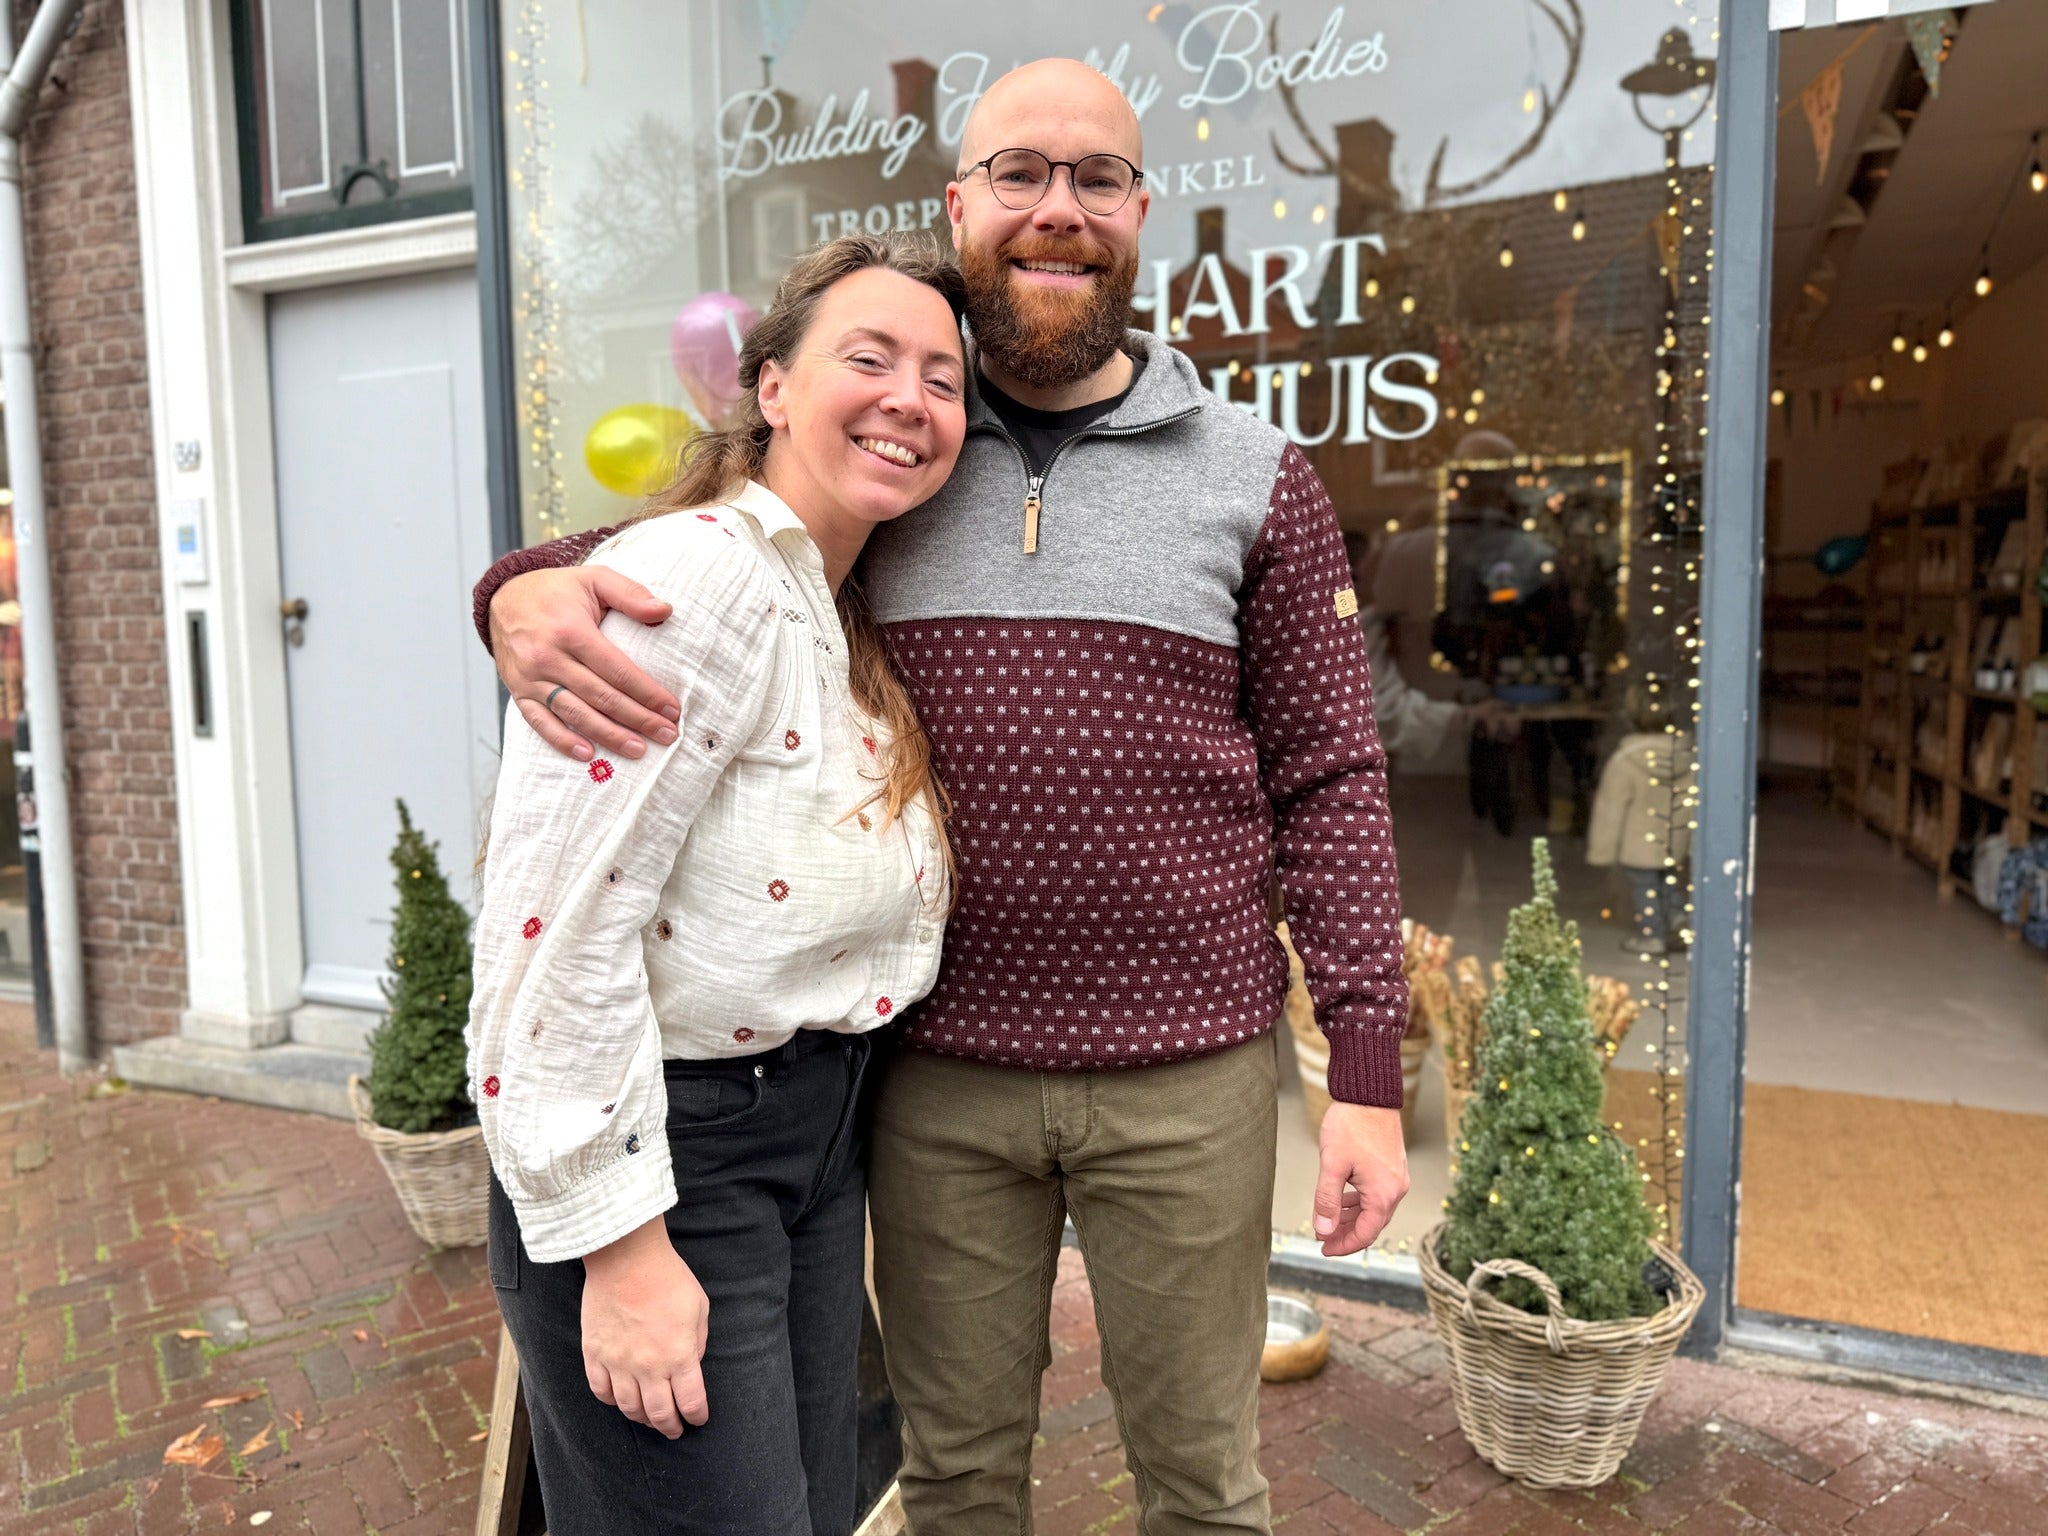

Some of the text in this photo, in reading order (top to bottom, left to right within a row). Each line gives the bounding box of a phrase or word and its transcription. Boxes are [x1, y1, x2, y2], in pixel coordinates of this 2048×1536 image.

[715, 87, 928, 181] Building
[1176, 2, 1389, 109] Bodies
[811, 154, 1266, 242] TROEP NKEL
